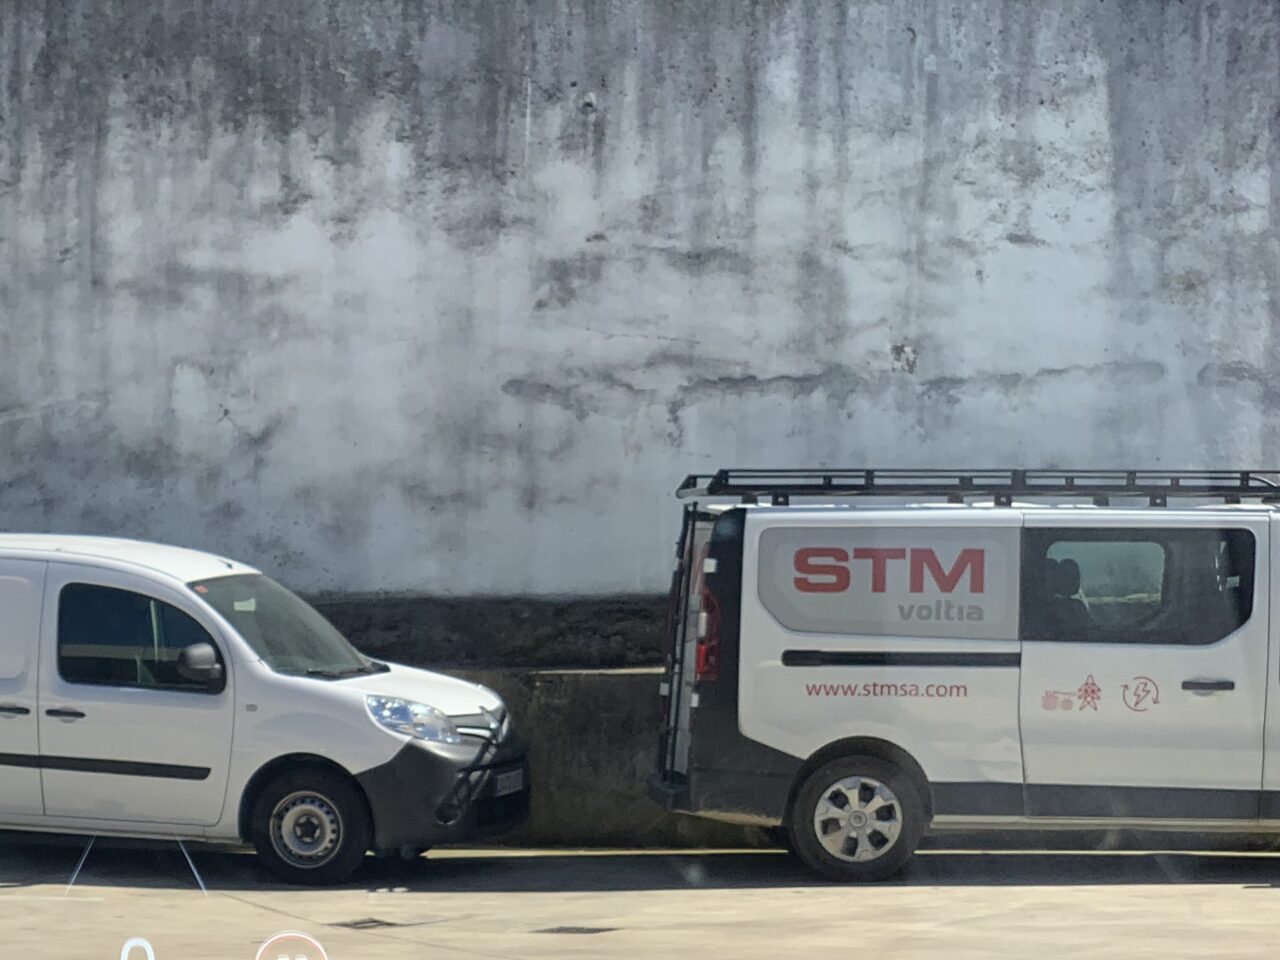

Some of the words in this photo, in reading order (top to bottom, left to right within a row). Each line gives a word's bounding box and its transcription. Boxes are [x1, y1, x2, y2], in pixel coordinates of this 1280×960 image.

[793, 547, 985, 593] STM
[897, 600, 985, 622] voltia
[805, 682, 968, 698] www.stmsa.com
